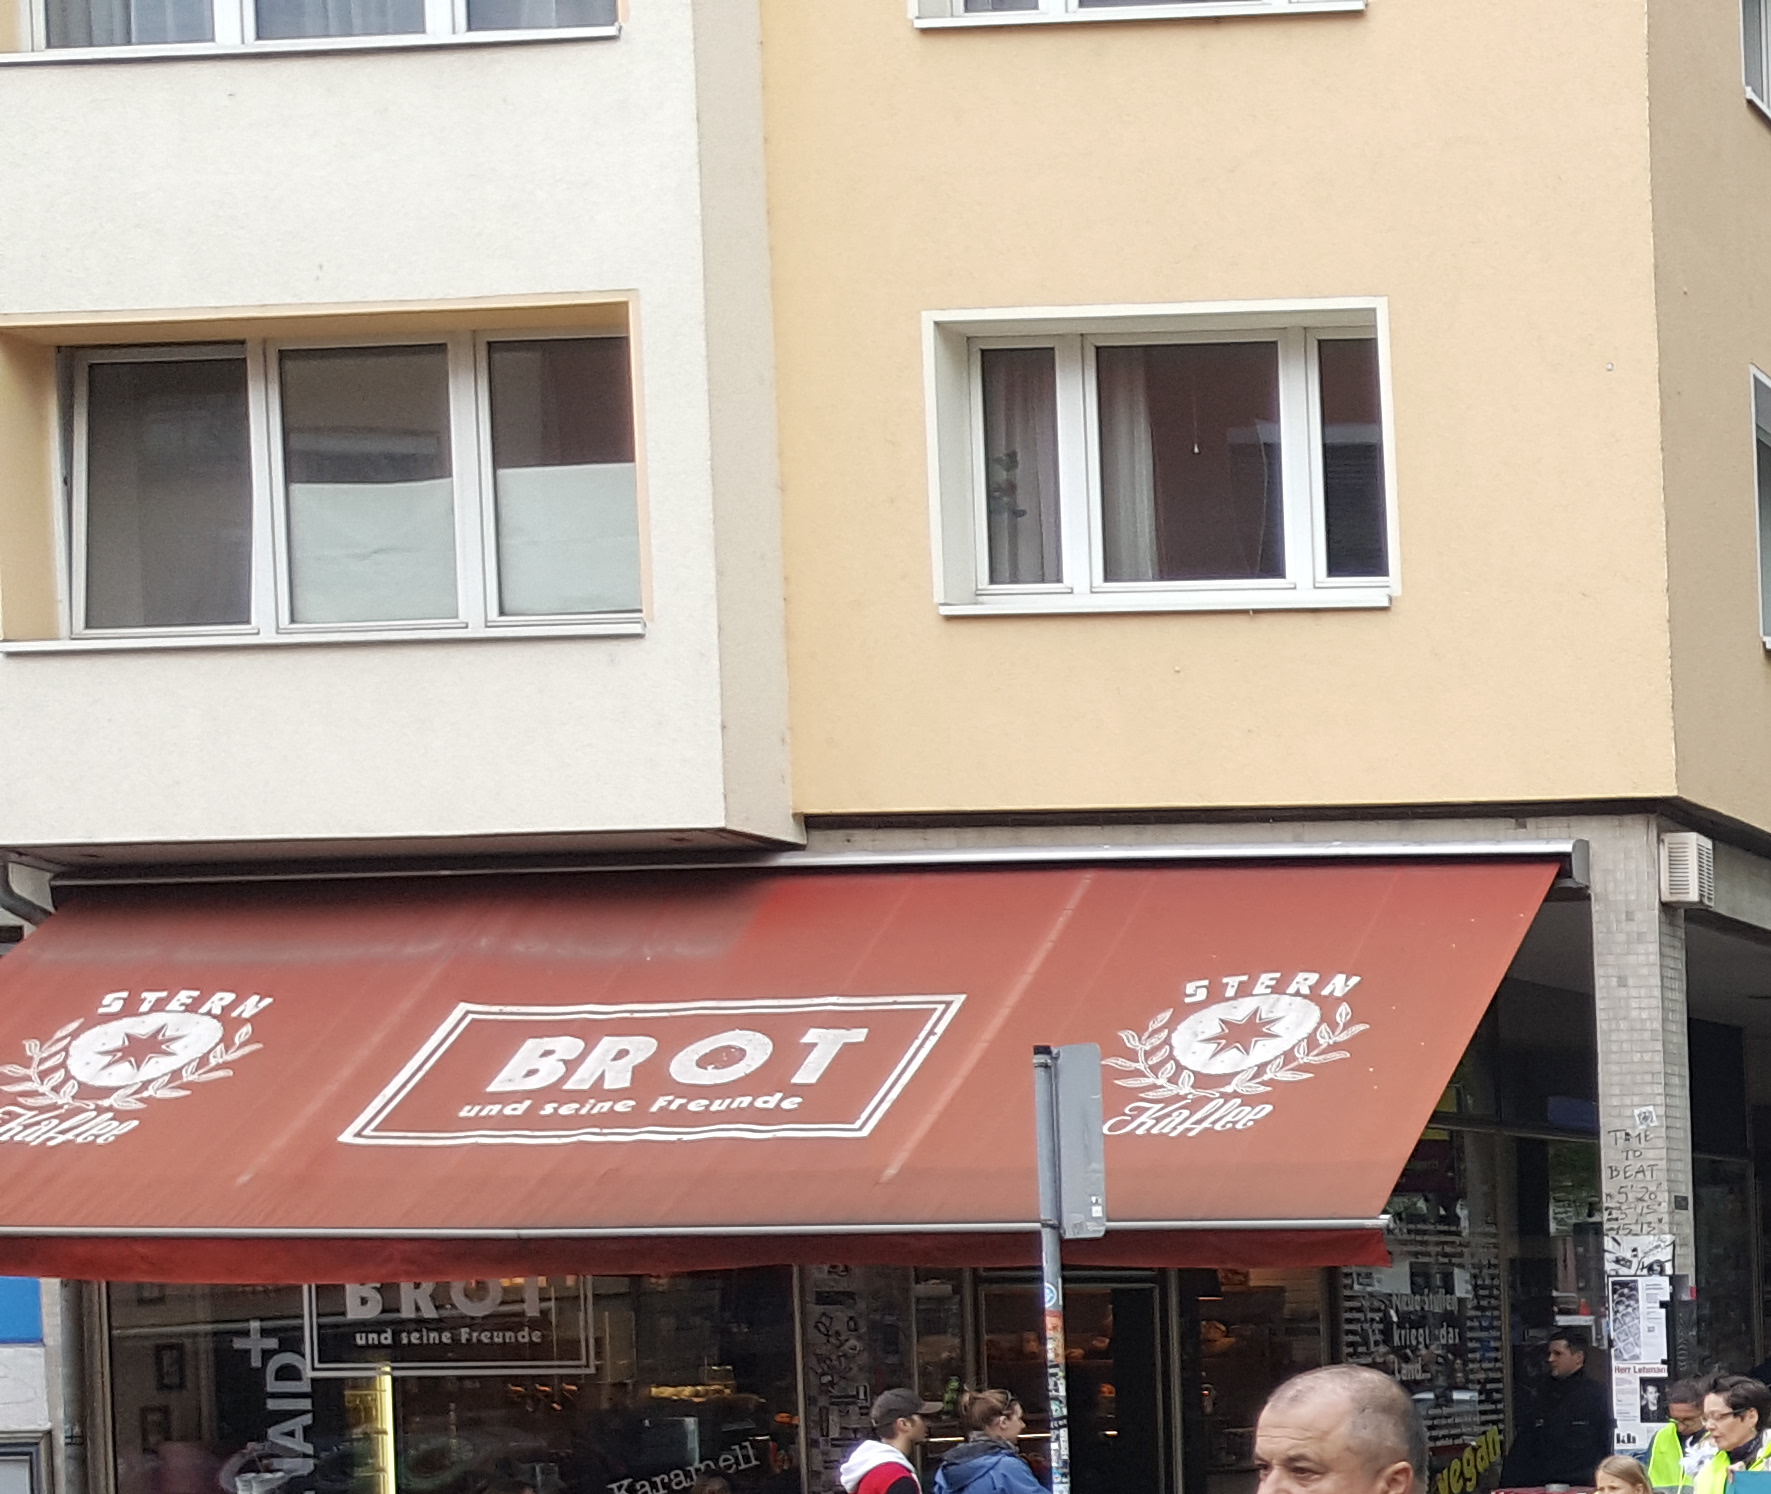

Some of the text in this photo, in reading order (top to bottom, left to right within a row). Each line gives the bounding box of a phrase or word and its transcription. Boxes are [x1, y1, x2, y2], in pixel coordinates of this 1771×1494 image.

[1184, 972, 1361, 1003] STERN
[98, 990, 273, 1019] STERN
[486, 1027, 869, 1092] BROT
[458, 1091, 803, 1119] und seine Freunde
[1102, 1098, 1274, 1138] Kaffee
[0, 1106, 140, 1146] Kaffee
[1621, 1149, 1643, 1160] TO
[1607, 1163, 1659, 1179] BEAT
[346, 1282, 550, 1319] BROT
[355, 1325, 544, 1347] und seine Freunde
[1614, 1365, 1631, 1374] Herr
